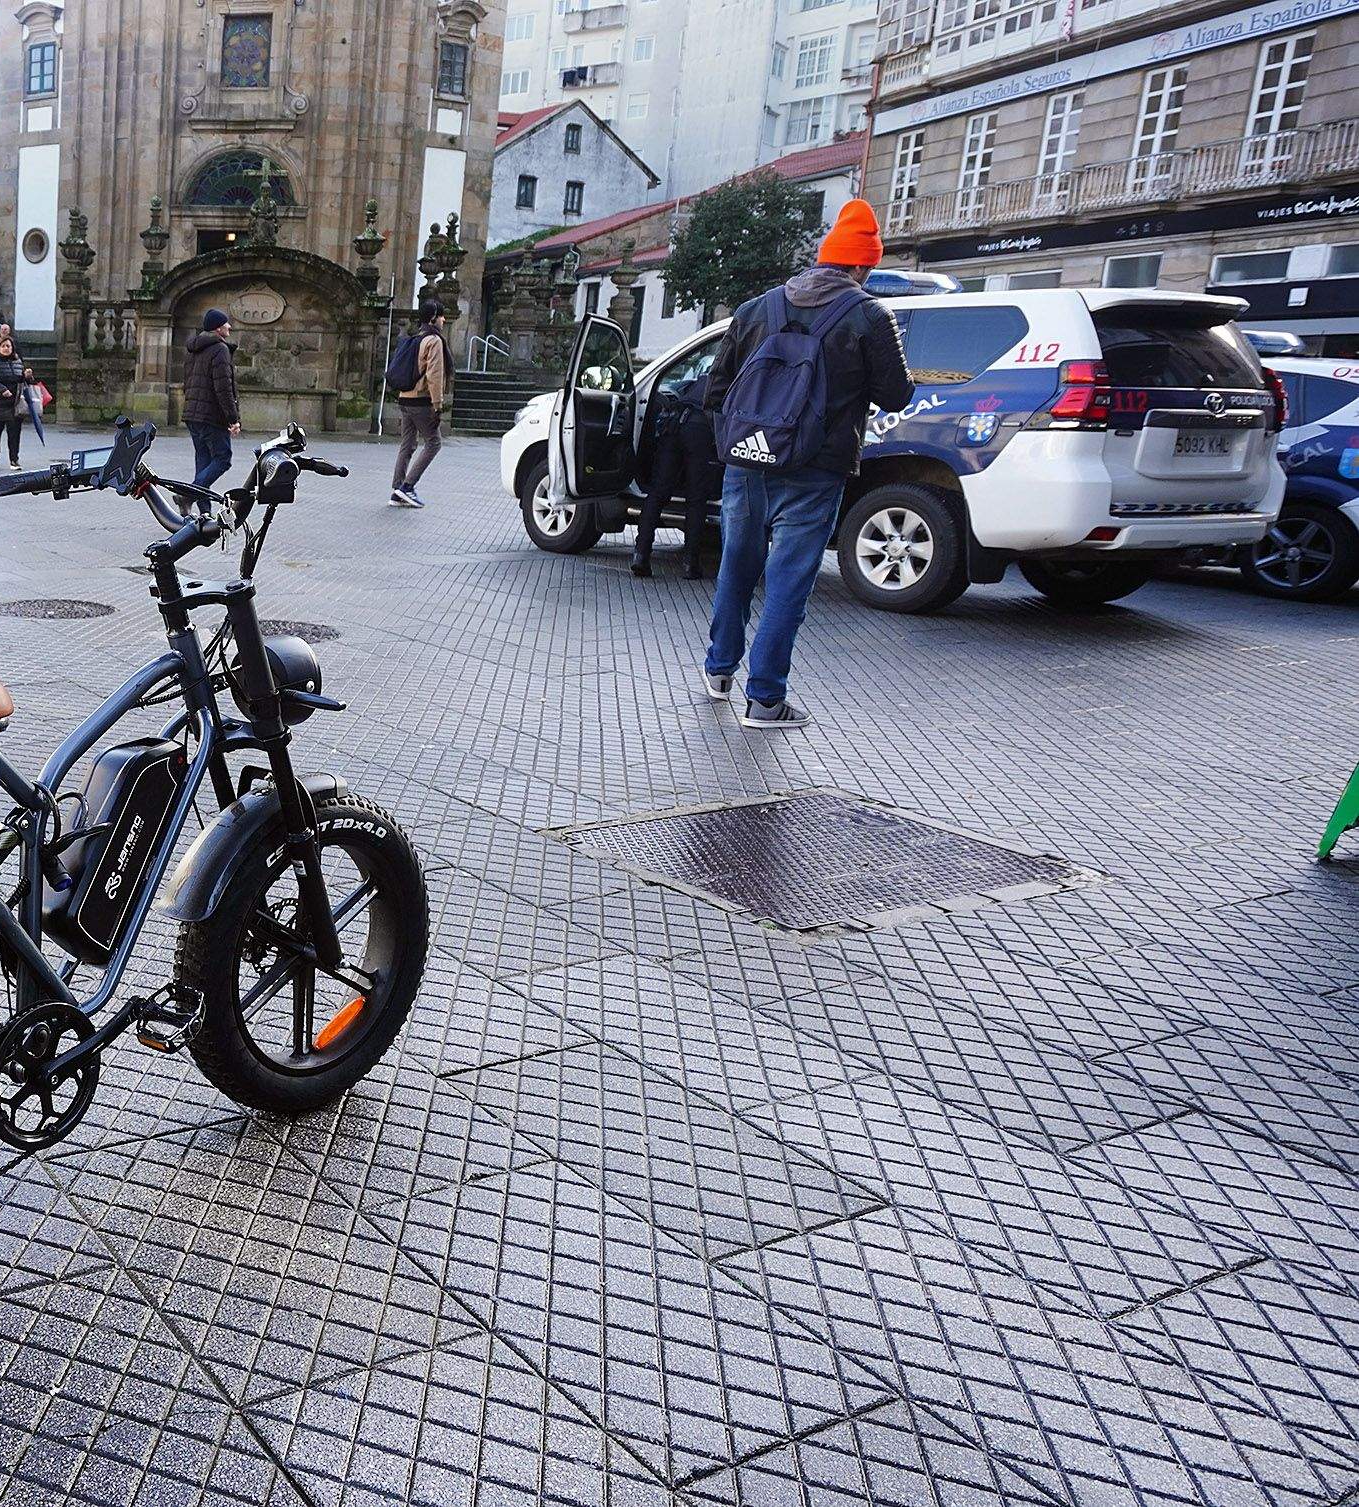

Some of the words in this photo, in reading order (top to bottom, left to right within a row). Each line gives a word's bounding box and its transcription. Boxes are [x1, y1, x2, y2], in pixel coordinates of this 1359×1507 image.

[1181, 22, 1242, 49] Alianza
[1249, 0, 1331, 31] Española
[931, 96, 969, 116] Alianza
[972, 80, 1020, 104] Española
[1024, 67, 1072, 89] Seguros
[1257, 206, 1293, 218] VIAJES
[1015, 343, 1061, 363] 112
[1114, 391, 1148, 412] 112
[873, 393, 947, 435] LOCAL
[731, 447, 776, 463] adidas
[332, 818, 387, 839] 20x4.0
